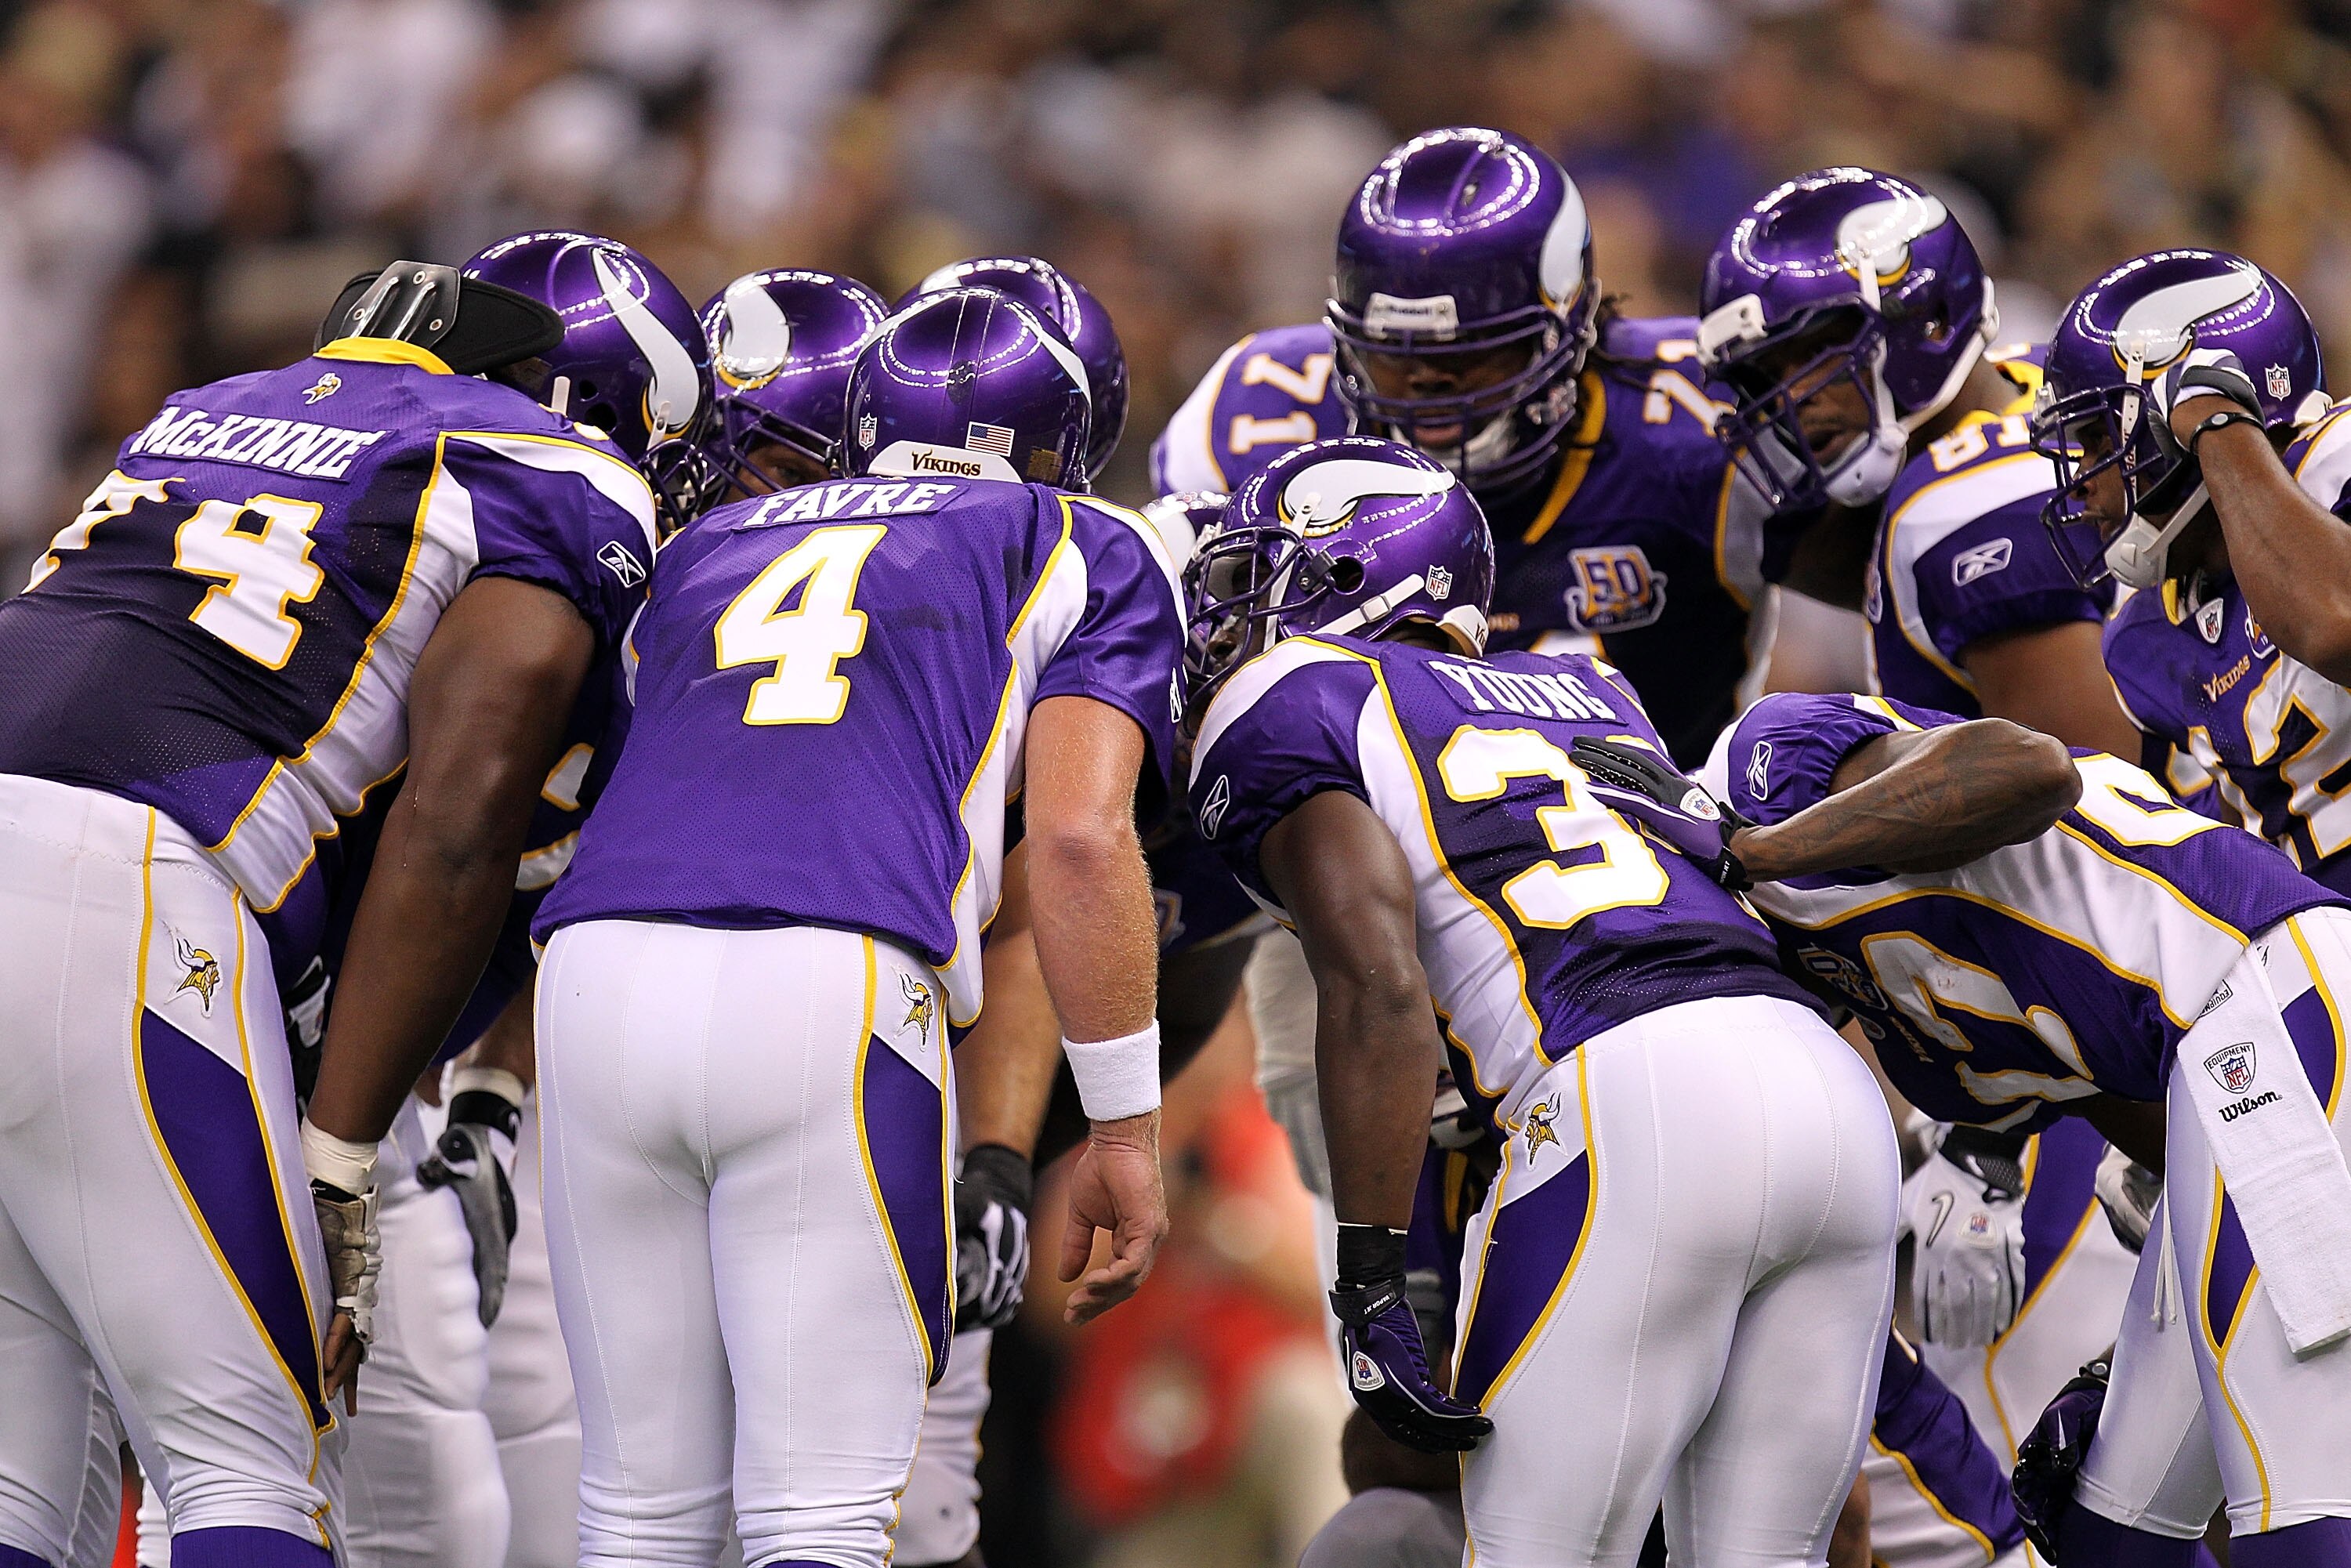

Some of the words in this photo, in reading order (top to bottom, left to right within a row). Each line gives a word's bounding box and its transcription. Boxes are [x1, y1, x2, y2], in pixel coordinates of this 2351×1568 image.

[2271, 379, 2288, 393] NFL
[1229, 353, 1333, 454] 71
[861, 429, 875, 443] NFL
[911, 448, 982, 477] VIKINGS
[743, 482, 957, 527] FAVRE
[1429, 577, 1447, 596] NFL
[714, 525, 888, 726] 4
[1427, 660, 1617, 720] YOUNG
[2203, 654, 2251, 703] VIKINGS
[1436, 724, 1683, 930] 3
[2201, 989, 2232, 1014] EQUIPM
[2208, 1045, 2251, 1070] EQUIPMENT
[2226, 1067, 2248, 1089] NFL
[2219, 1092, 2278, 1122] Wilson
[1371, 1295, 1390, 1309] VAPOR
